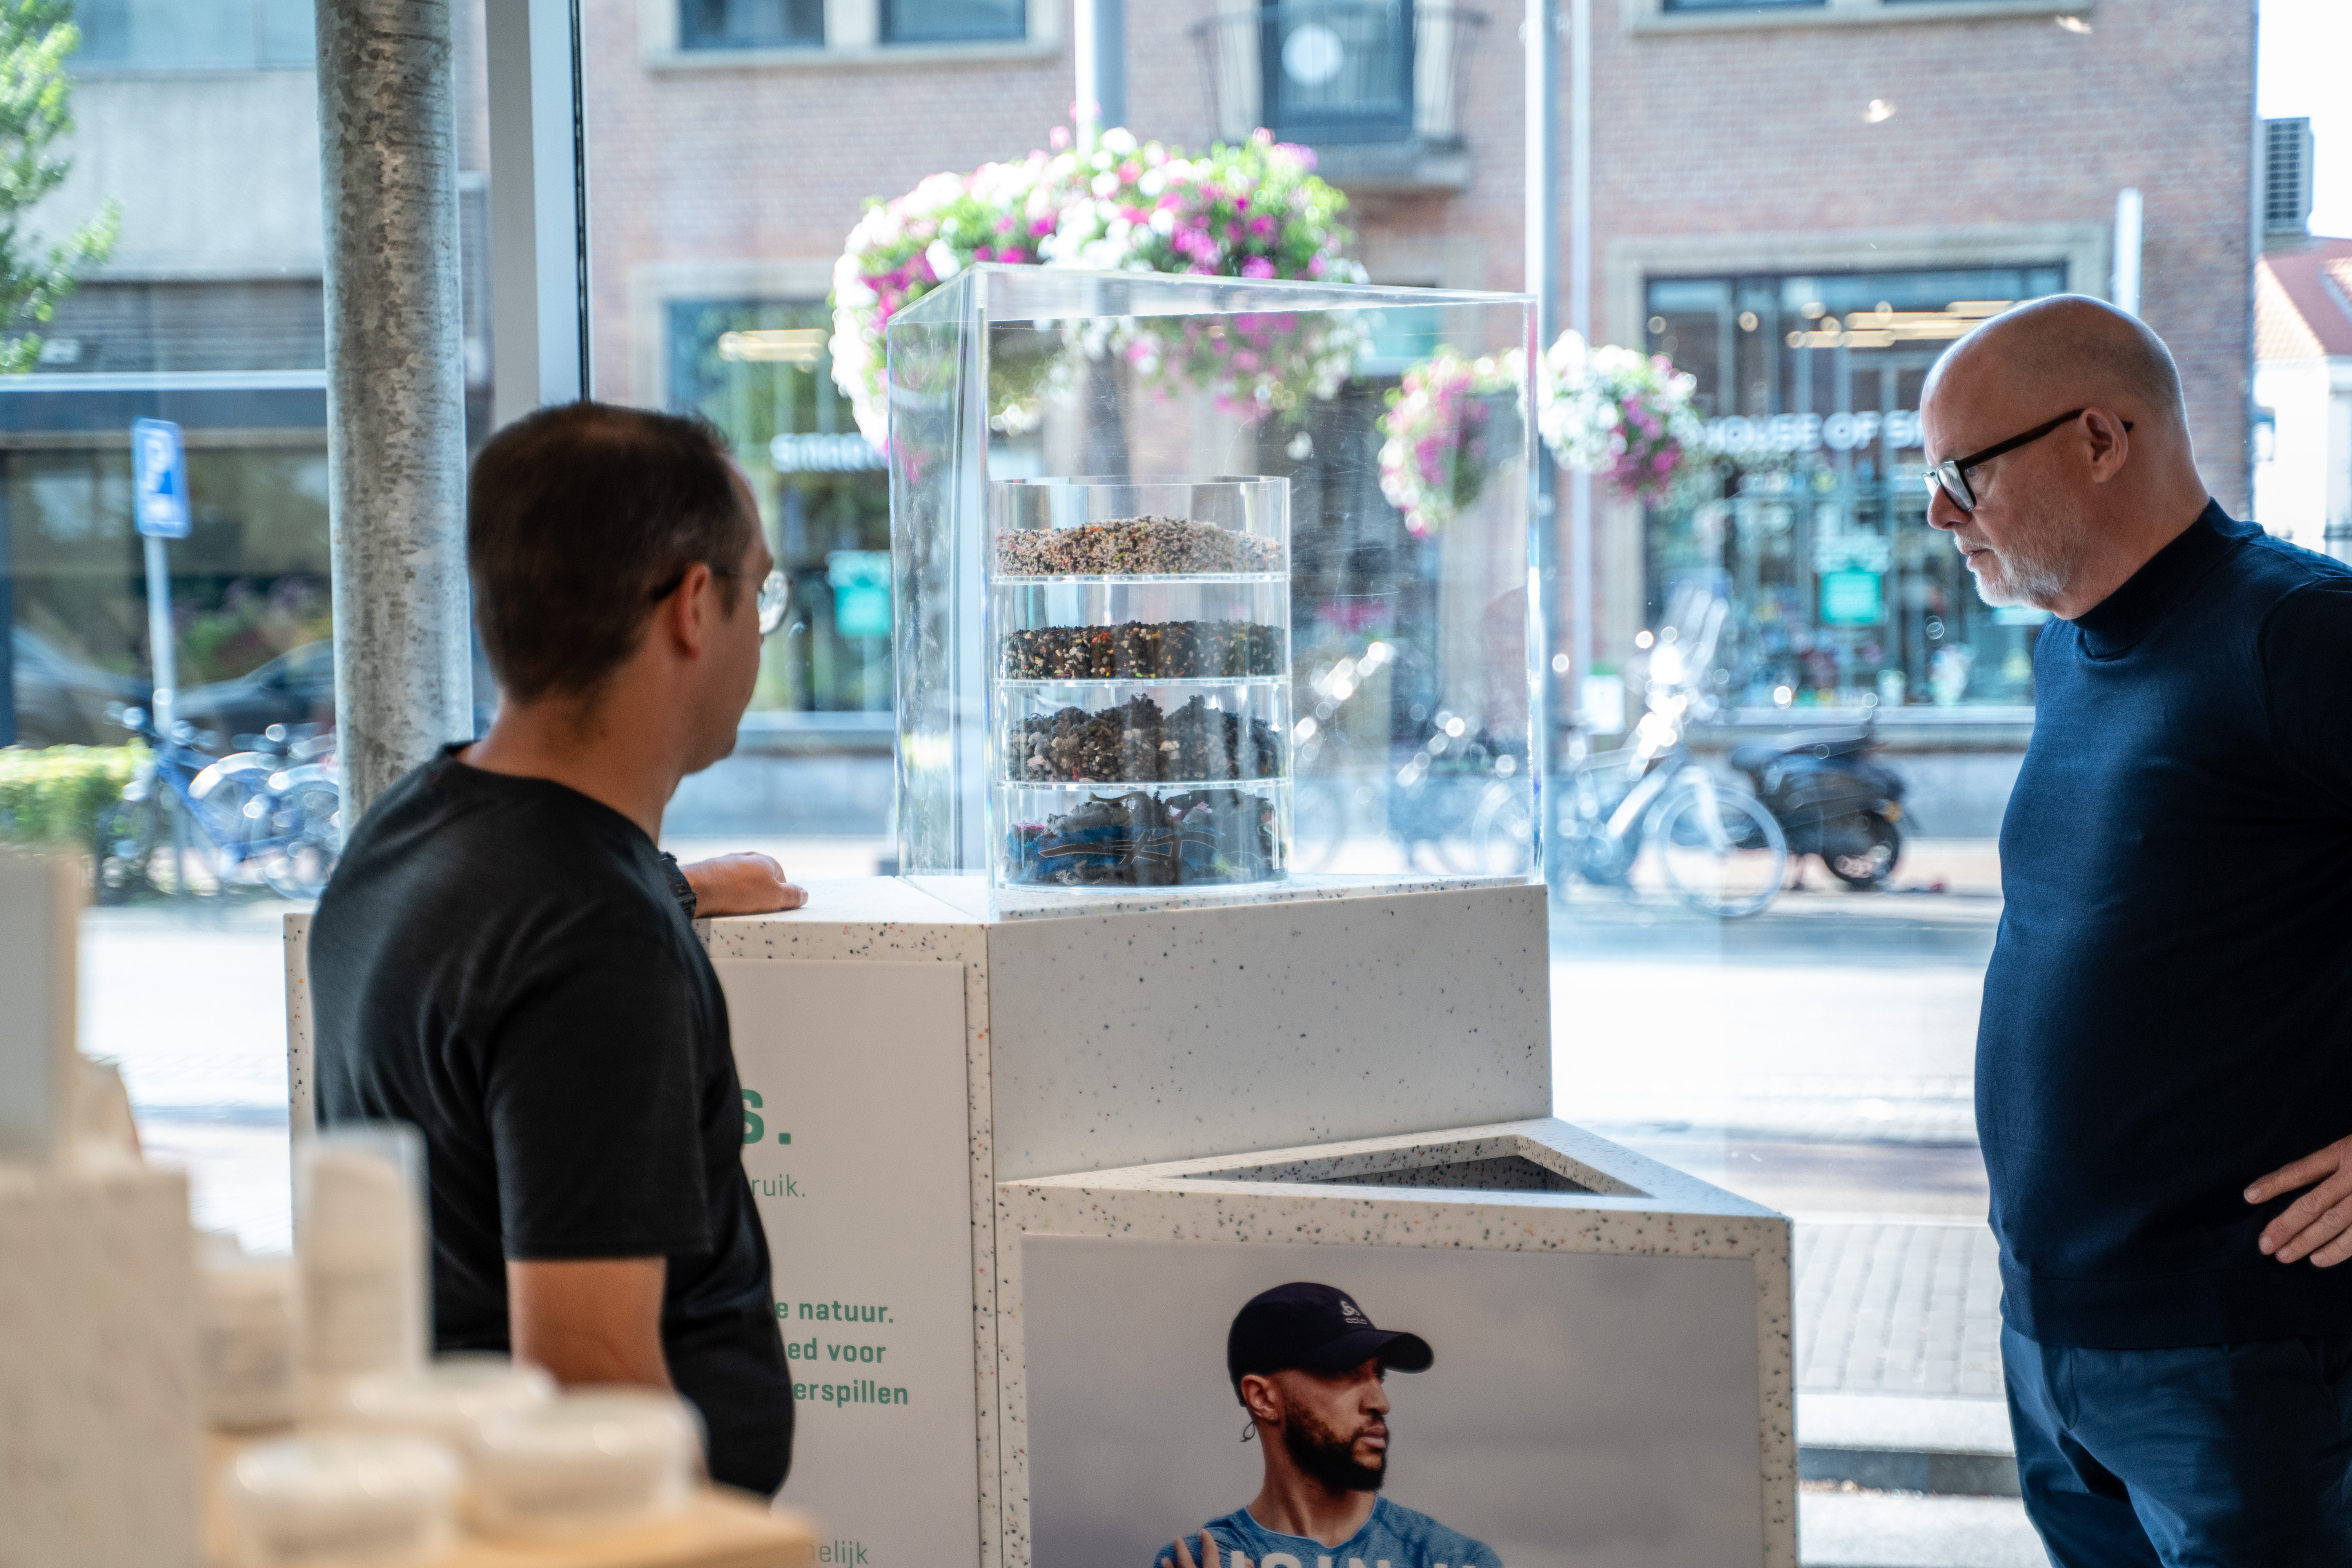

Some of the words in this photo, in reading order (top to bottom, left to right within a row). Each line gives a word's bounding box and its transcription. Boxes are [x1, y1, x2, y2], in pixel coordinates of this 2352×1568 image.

[751, 1174, 806, 1197] ruik.
[776, 1302, 789, 1319] e
[799, 1301, 894, 1324] natuur.
[788, 1337, 817, 1361] ed
[826, 1344, 887, 1364] voor
[793, 1379, 908, 1408] erspillen
